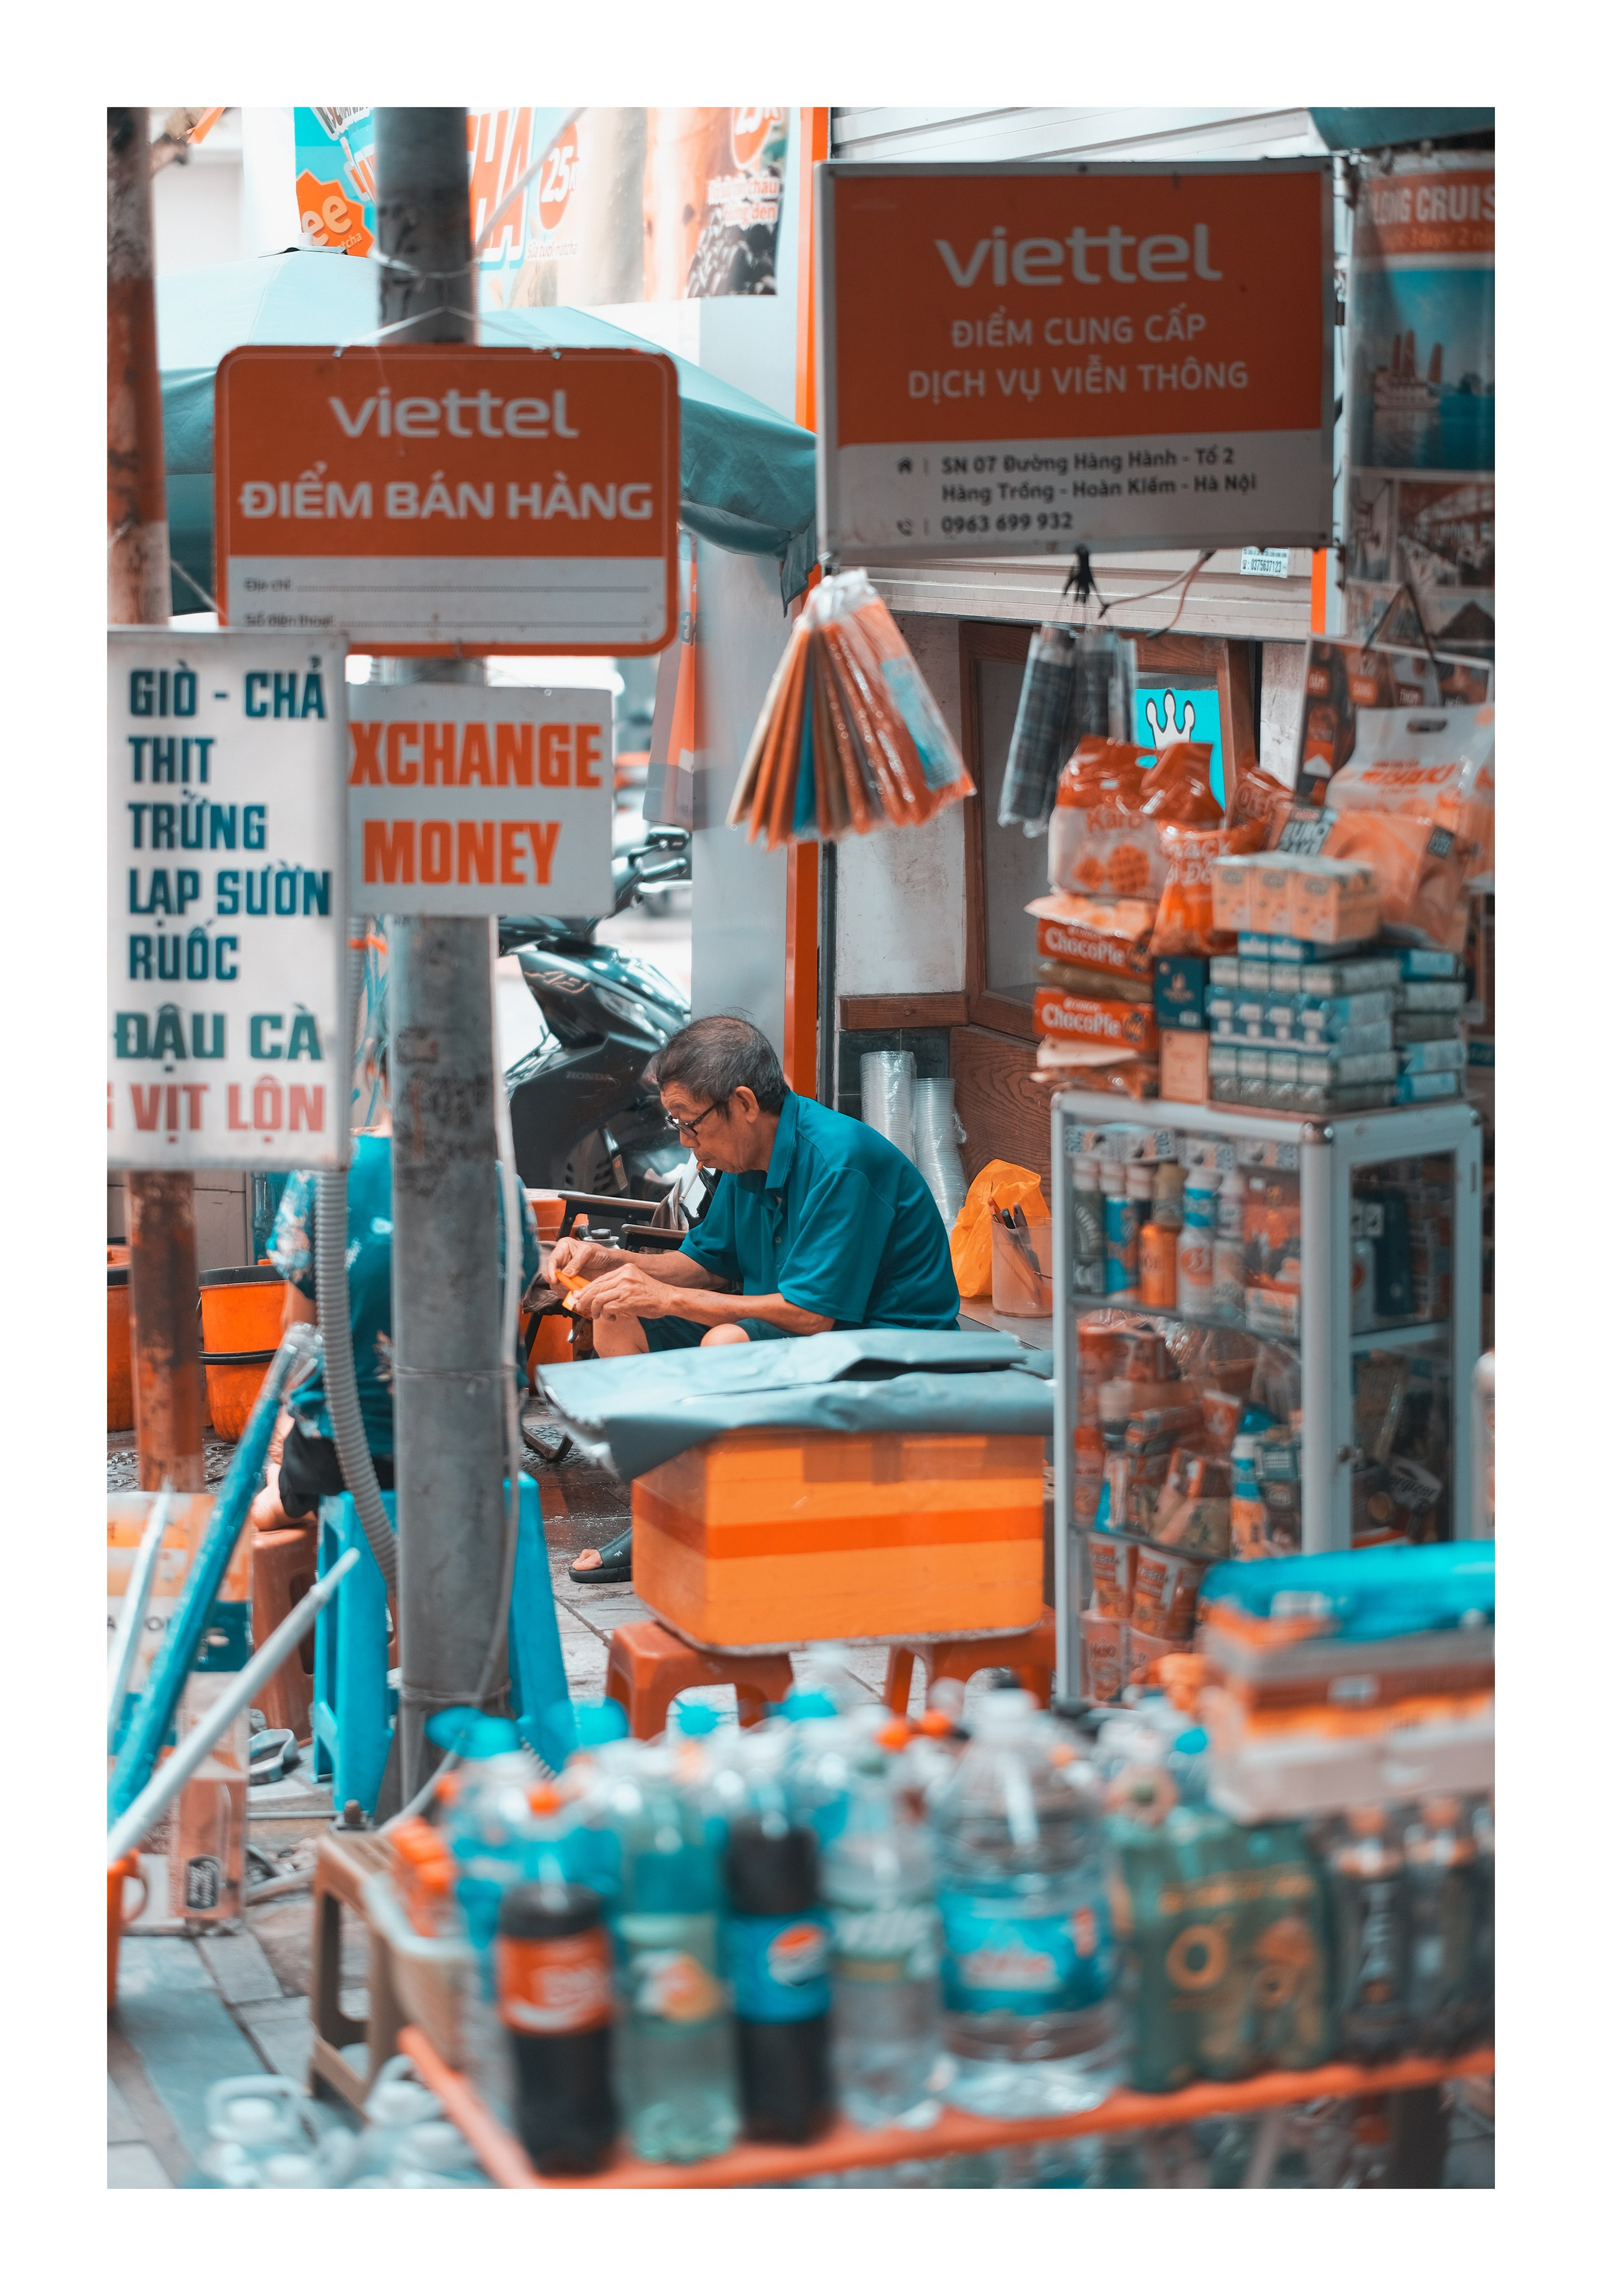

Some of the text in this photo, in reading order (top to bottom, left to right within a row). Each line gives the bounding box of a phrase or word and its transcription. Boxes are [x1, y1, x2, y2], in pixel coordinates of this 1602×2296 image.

[935, 223, 1223, 288] viettel
[951, 302, 1206, 348] ĐIỂM CUNG CẤP
[907, 354, 1250, 405] DỊCH VỤ VIỄN THÔNG
[329, 387, 580, 438] viettel
[941, 455, 968, 475] SN
[974, 454, 997, 474] 07
[1003, 454, 1068, 476] Đường
[1074, 451, 1123, 474] Hàng
[1128, 448, 1177, 469] Hành
[1223, 446, 1235, 465] 2
[240, 462, 654, 520] ĐIỂM BÁN HÀNG
[942, 484, 992, 507] Hàng
[1073, 477, 1123, 499] Hoàn
[1194, 474, 1218, 494] Hà
[1225, 473, 1257, 496] Nội
[941, 511, 1073, 534] 0963 699 932
[130, 659, 196, 717] GIÒ
[245, 655, 324, 718] CHẢ
[348, 722, 602, 788] XCHANGE
[363, 819, 562, 886] MONEY
[217, 860, 330, 916] SƯỜN
[129, 920, 240, 981] RUỐC
[1044, 927, 1125, 967] ChocoPie
[113, 1001, 323, 1073] ĐẬU CÀ
[1041, 1004, 1121, 1038] ChocoPie
[566, 1070, 612, 1082] HONDA
[129, 1082, 209, 1144] VỊT
[227, 1074, 324, 1144] LỘN
